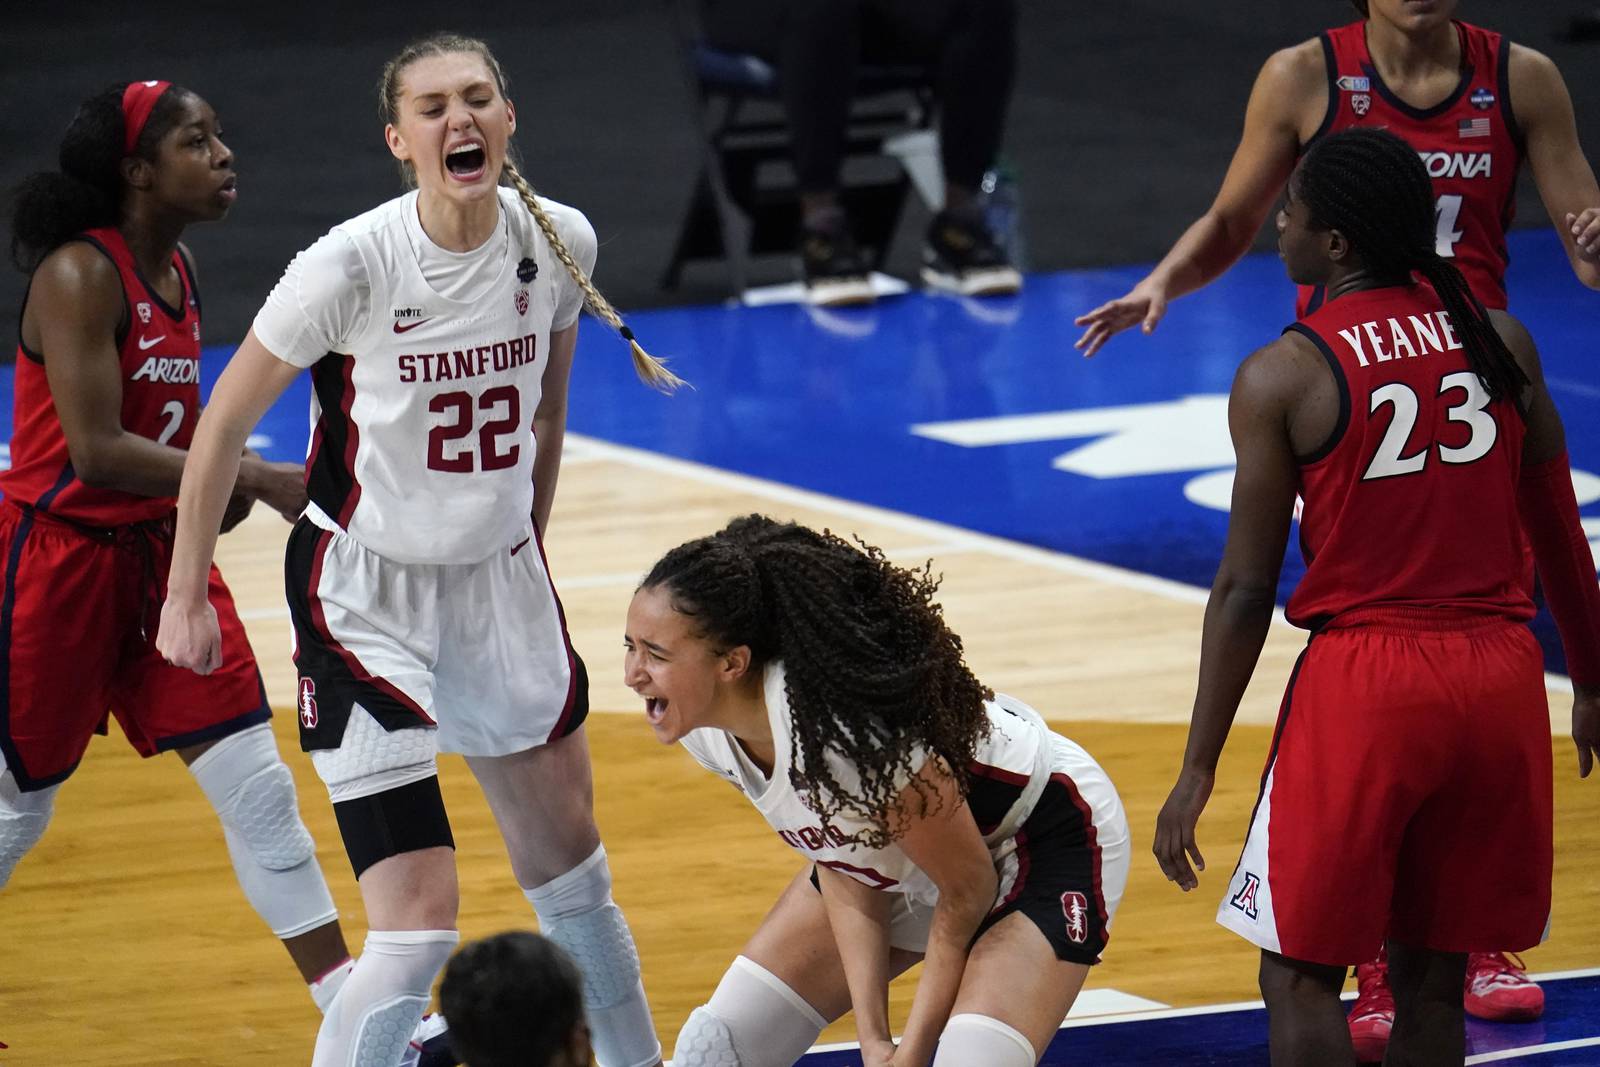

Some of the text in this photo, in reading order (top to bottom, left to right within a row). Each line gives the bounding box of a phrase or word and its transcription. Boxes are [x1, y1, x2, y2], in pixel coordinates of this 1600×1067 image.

[399, 334, 536, 382] STANFORD
[160, 401, 184, 444] 2
[427, 385, 520, 473] 22
[1362, 371, 1498, 480] 23
[1230, 872, 1260, 920] A
